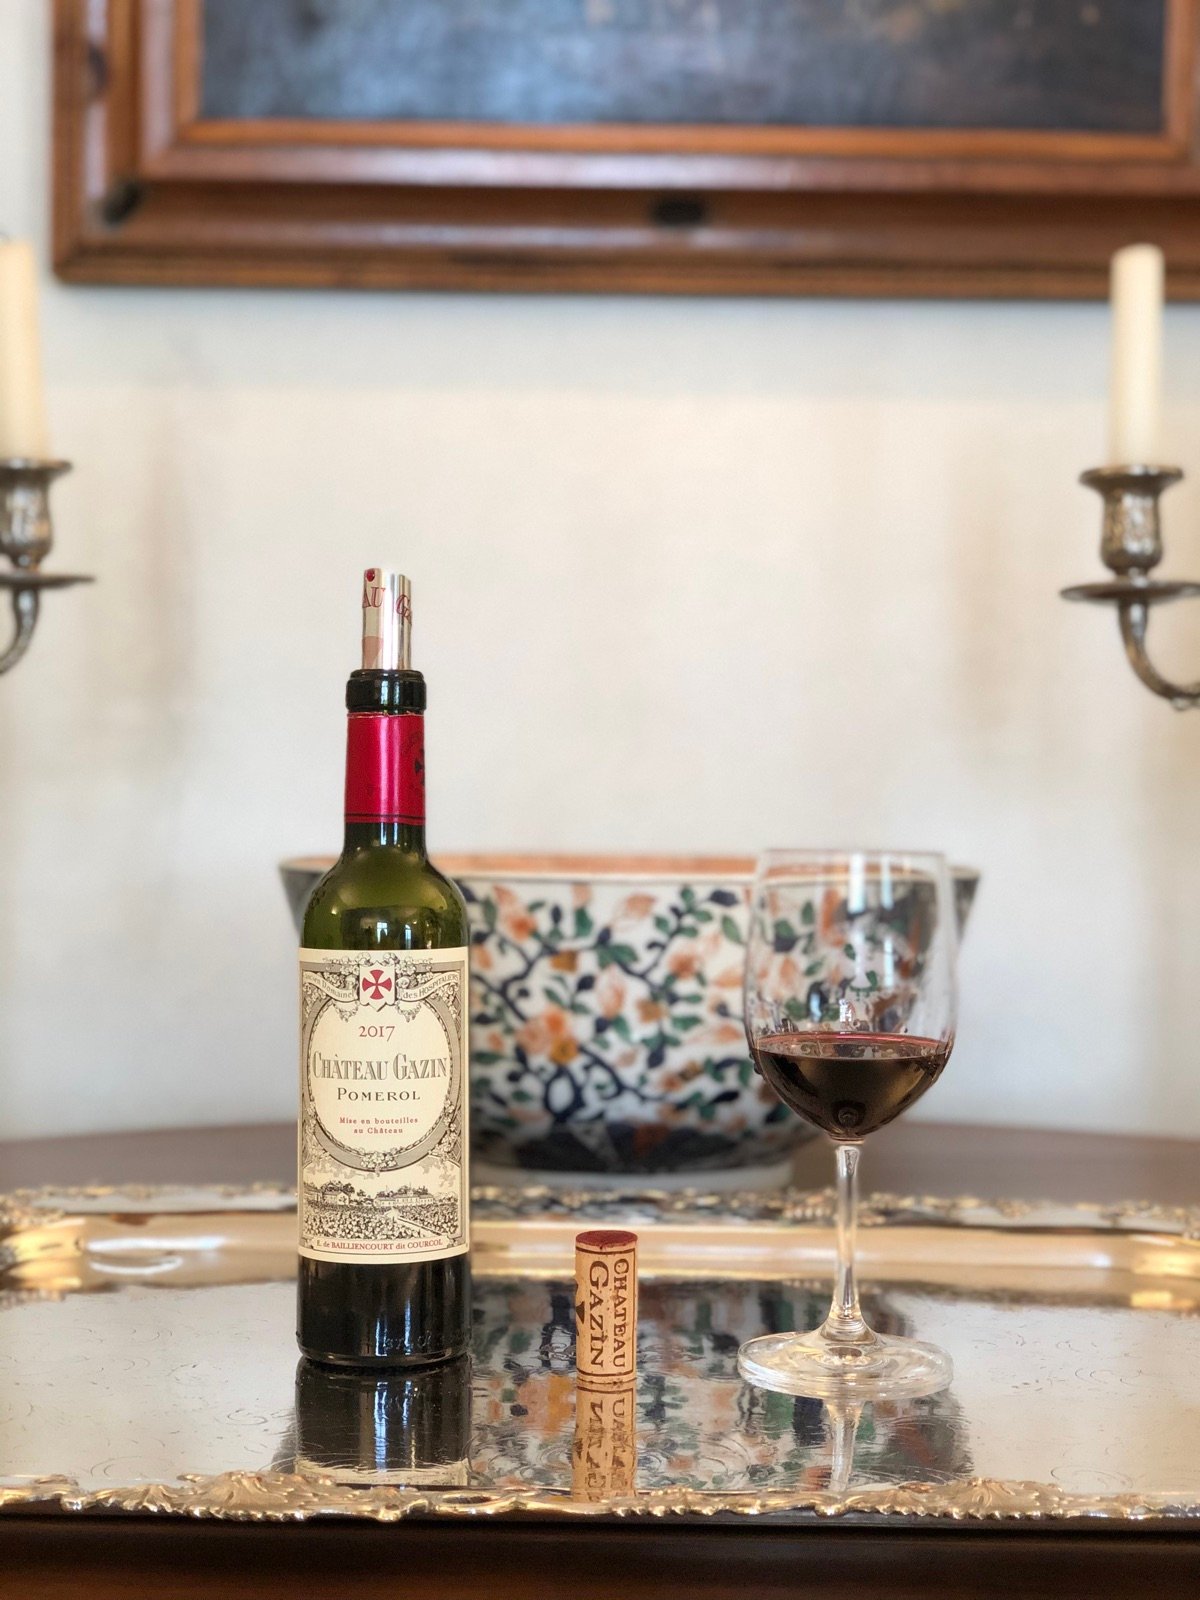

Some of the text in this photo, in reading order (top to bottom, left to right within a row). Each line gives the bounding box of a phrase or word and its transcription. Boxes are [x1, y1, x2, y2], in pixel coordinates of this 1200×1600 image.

[359, 1025, 396, 1042] 2017
[393, 1052, 447, 1080] GAZIN
[337, 1087, 421, 1101] POMEROL
[339, 1117, 357, 1125] Mise
[374, 1117, 419, 1125] bouteilles
[331, 1241, 394, 1250] BAILLIENCOURT
[395, 1242, 406, 1250] dit
[407, 1238, 443, 1249] COURCOL
[589, 1260, 610, 1369] GAZIN
[612, 1258, 630, 1369] CHATEAU
